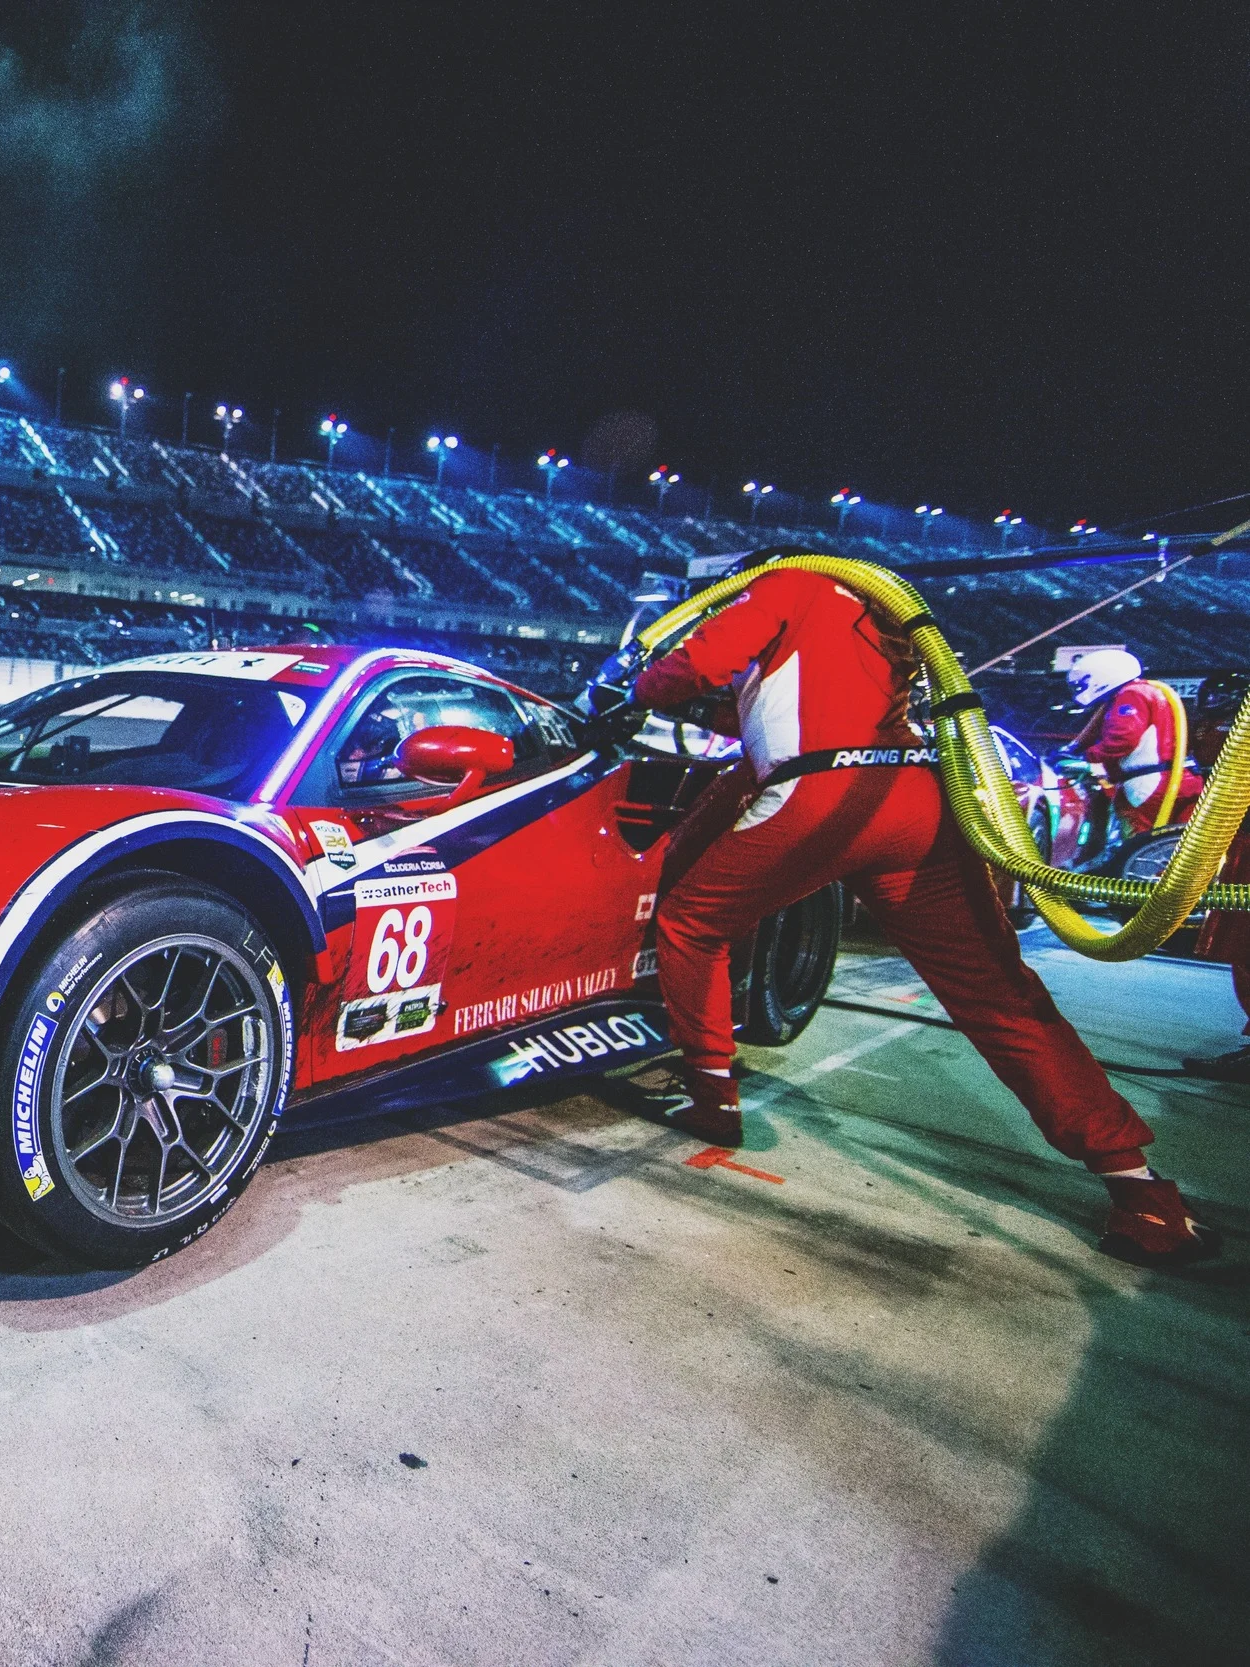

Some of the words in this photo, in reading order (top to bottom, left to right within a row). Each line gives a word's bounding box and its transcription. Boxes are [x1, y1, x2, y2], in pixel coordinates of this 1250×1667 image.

[832, 749, 899, 768] RACING
[325, 835, 348, 848] 24
[58, 955, 88, 992] MICHELIN
[367, 905, 432, 994] 68
[453, 993, 518, 1036] FERRARI
[519, 978, 574, 1015] SILICON
[575, 967, 619, 1000] VALLEY
[277, 1001, 294, 1111] MICHELIN
[502, 1012, 664, 1073] HUBLOT
[16, 1018, 49, 1155] MICHELIN
